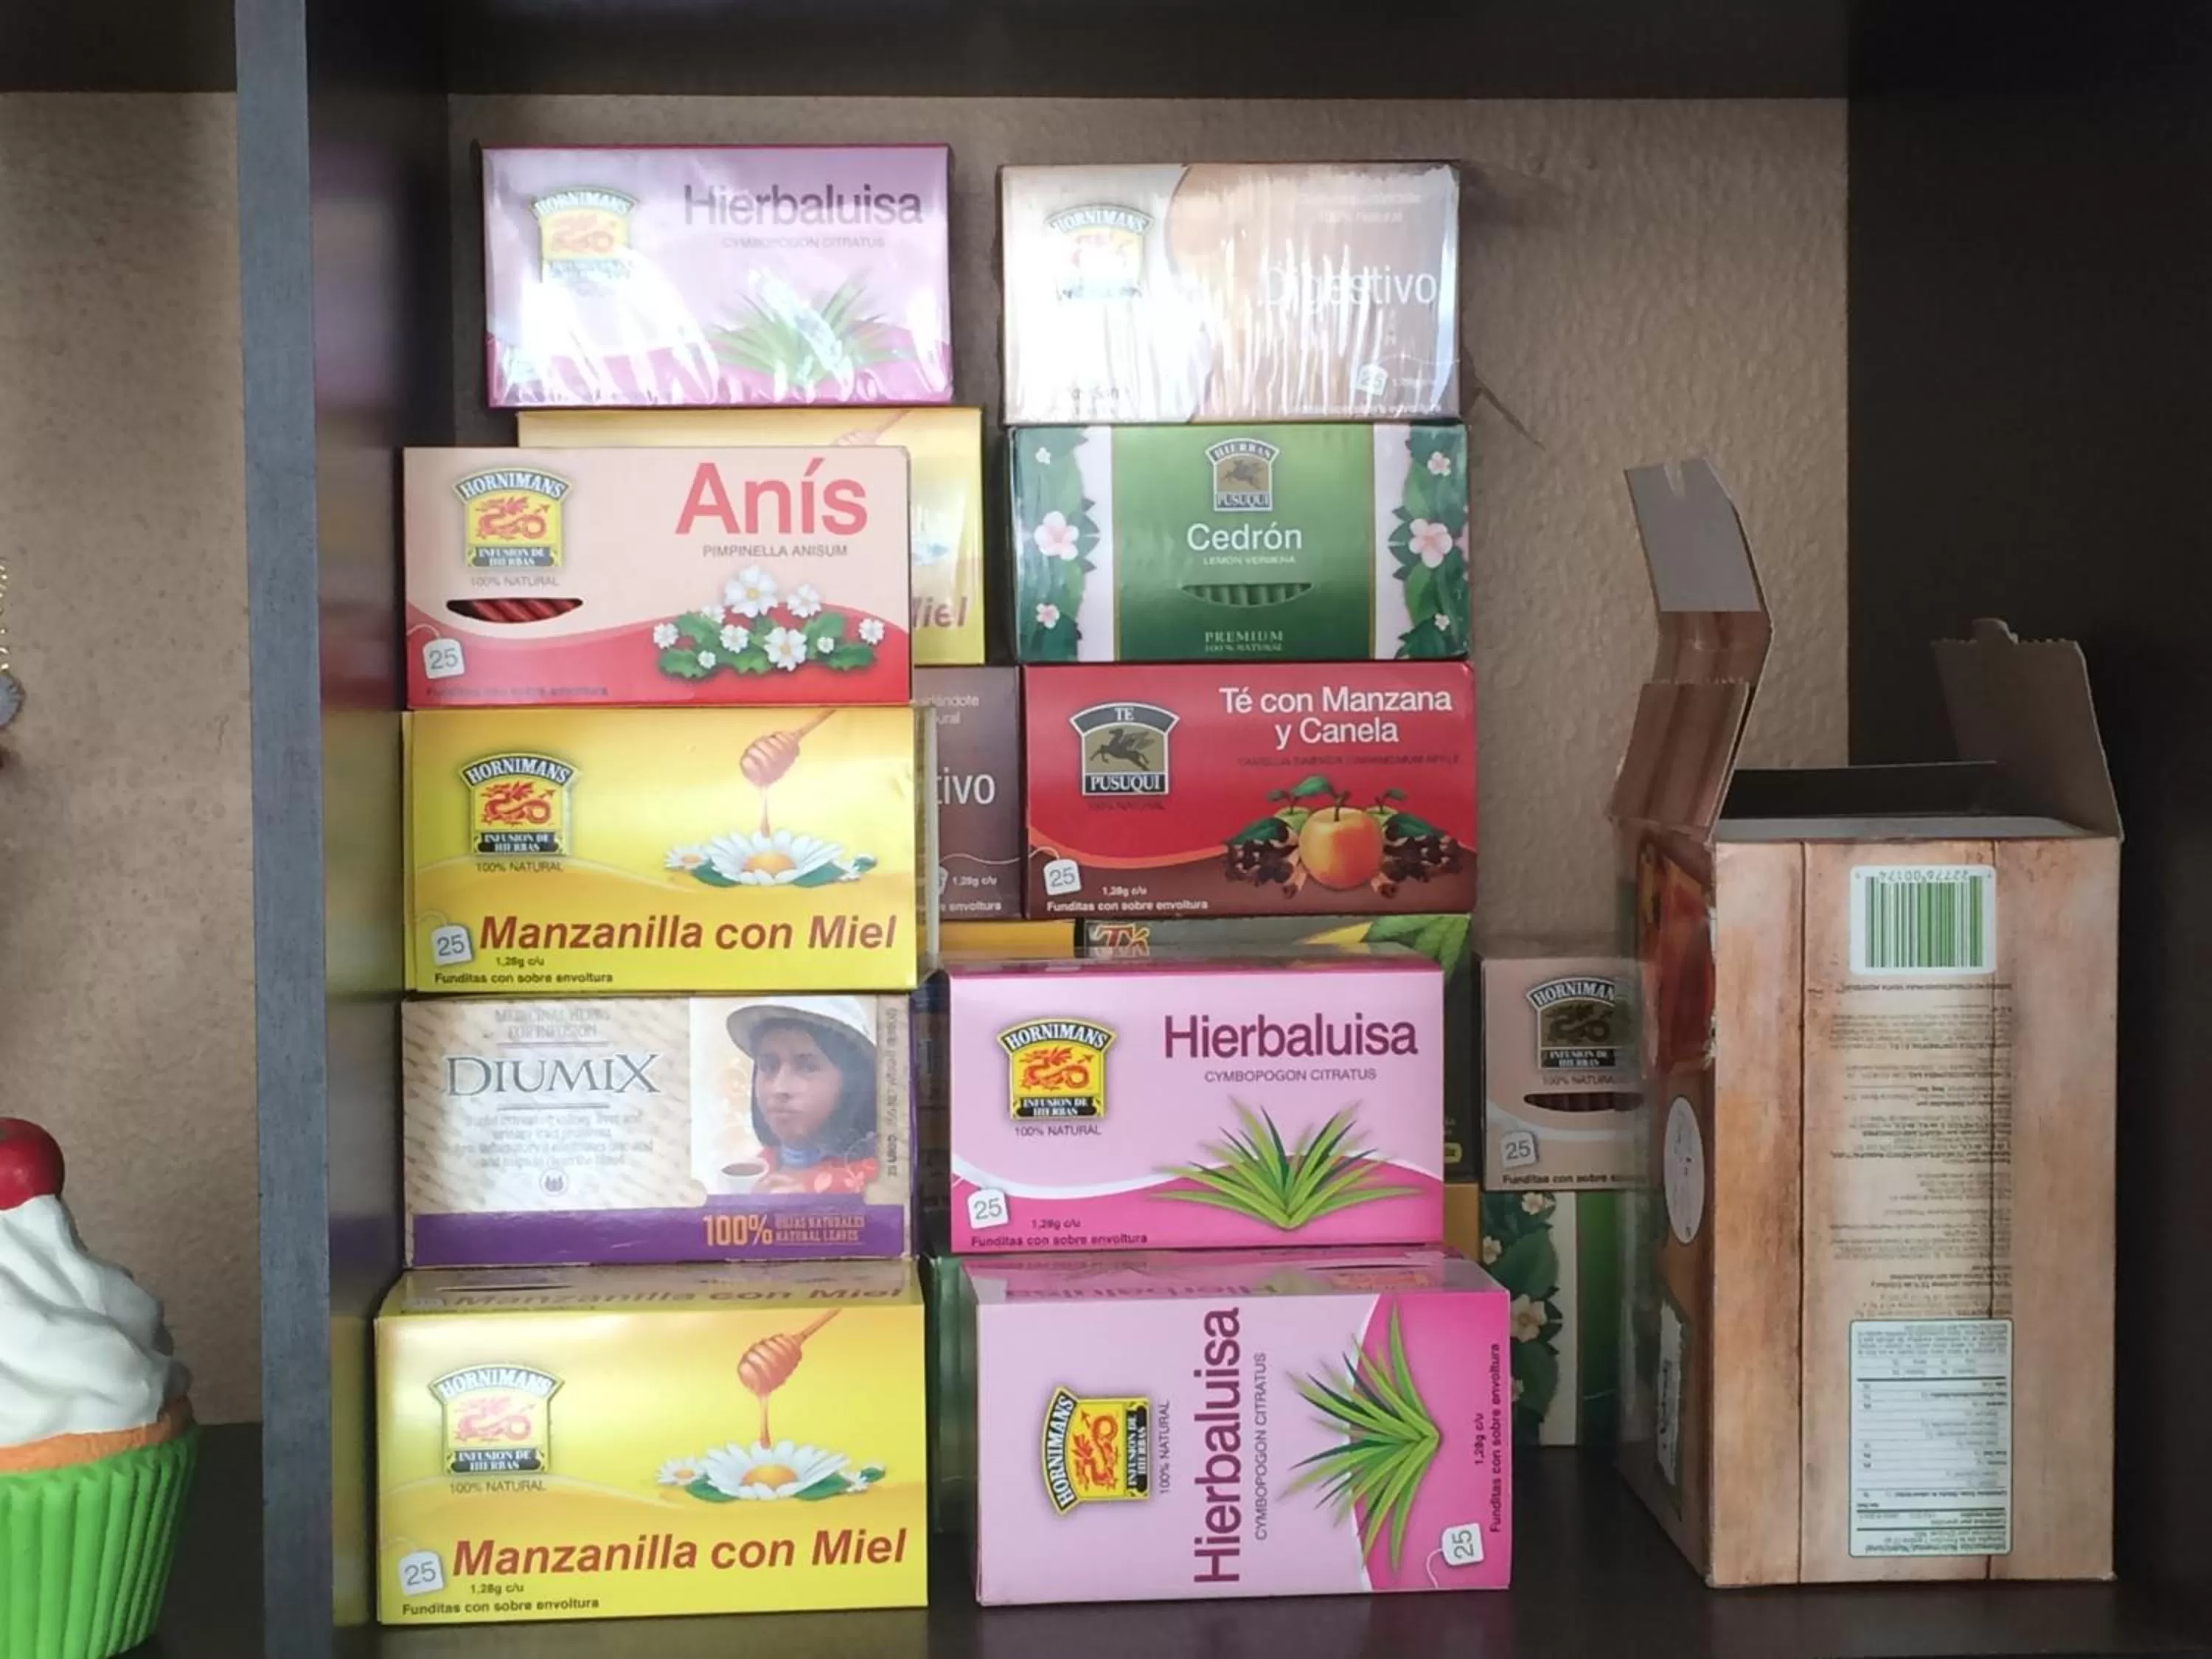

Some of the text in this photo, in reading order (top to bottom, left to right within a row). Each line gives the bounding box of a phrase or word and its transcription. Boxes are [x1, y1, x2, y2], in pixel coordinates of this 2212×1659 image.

[684, 184, 922, 226] Hierbaluisa
[1257, 264, 1437, 315] Digestivo
[460, 472, 566, 499] HORNIMANS
[675, 456, 869, 535] Anís
[1186, 521, 1303, 552] Cedrón
[702, 544, 848, 558] PIMPINELLA ANISUM
[503, 575, 560, 587] NATURAL
[1204, 630, 1284, 643] PREMIUM
[428, 647, 459, 671] 25
[1218, 686, 1453, 714] Té con Manzana
[1115, 707, 1135, 721] TE
[1274, 716, 1399, 751] y Canela
[467, 758, 571, 784] HORNIMANS
[1090, 775, 1161, 794] PUSUQUI
[476, 860, 563, 873] 100% NATURAL
[1049, 867, 1075, 887] 25
[1047, 900, 1208, 911] Funditas con sobre envoltura
[437, 933, 465, 956] 25
[479, 915, 897, 950] Manzanilla con Miel
[435, 973, 613, 984] Funditas con sobre envoltura
[1005, 1023, 1108, 1050] HORNIMANS
[1164, 1012, 1419, 1058] Hierbaluisa
[446, 1053, 661, 1096] DIUMIX
[1204, 1068, 1377, 1083] CYMBOPOGON CITRATUS
[1015, 1124, 1102, 1137] 100% NATURAL
[1505, 1140, 1531, 1161] 25
[973, 1198, 1003, 1220] 25
[703, 1214, 773, 1246] 100%
[971, 1234, 1147, 1246] Funditas con sobre envoltura
[438, 1369, 553, 1398] HORNIMANS
[1046, 1395, 1074, 1508] HORNIMANS
[1158, 1399, 1170, 1495] 100% NATURAL
[1194, 1307, 1242, 1583] Hierbaluisa
[1253, 1352, 1267, 1542] CYMBOPOGON CITRATUS
[1489, 1344, 1502, 1534] Funditas con sobre envoltura
[450, 1480, 547, 1494] 100% NATURAL
[453, 1528, 908, 1577] Manzanilla con Miel
[1452, 1530, 1474, 1559] 25
[404, 1559, 437, 1587] 25
[402, 1597, 599, 1615] Funditas con sobre envoltura
